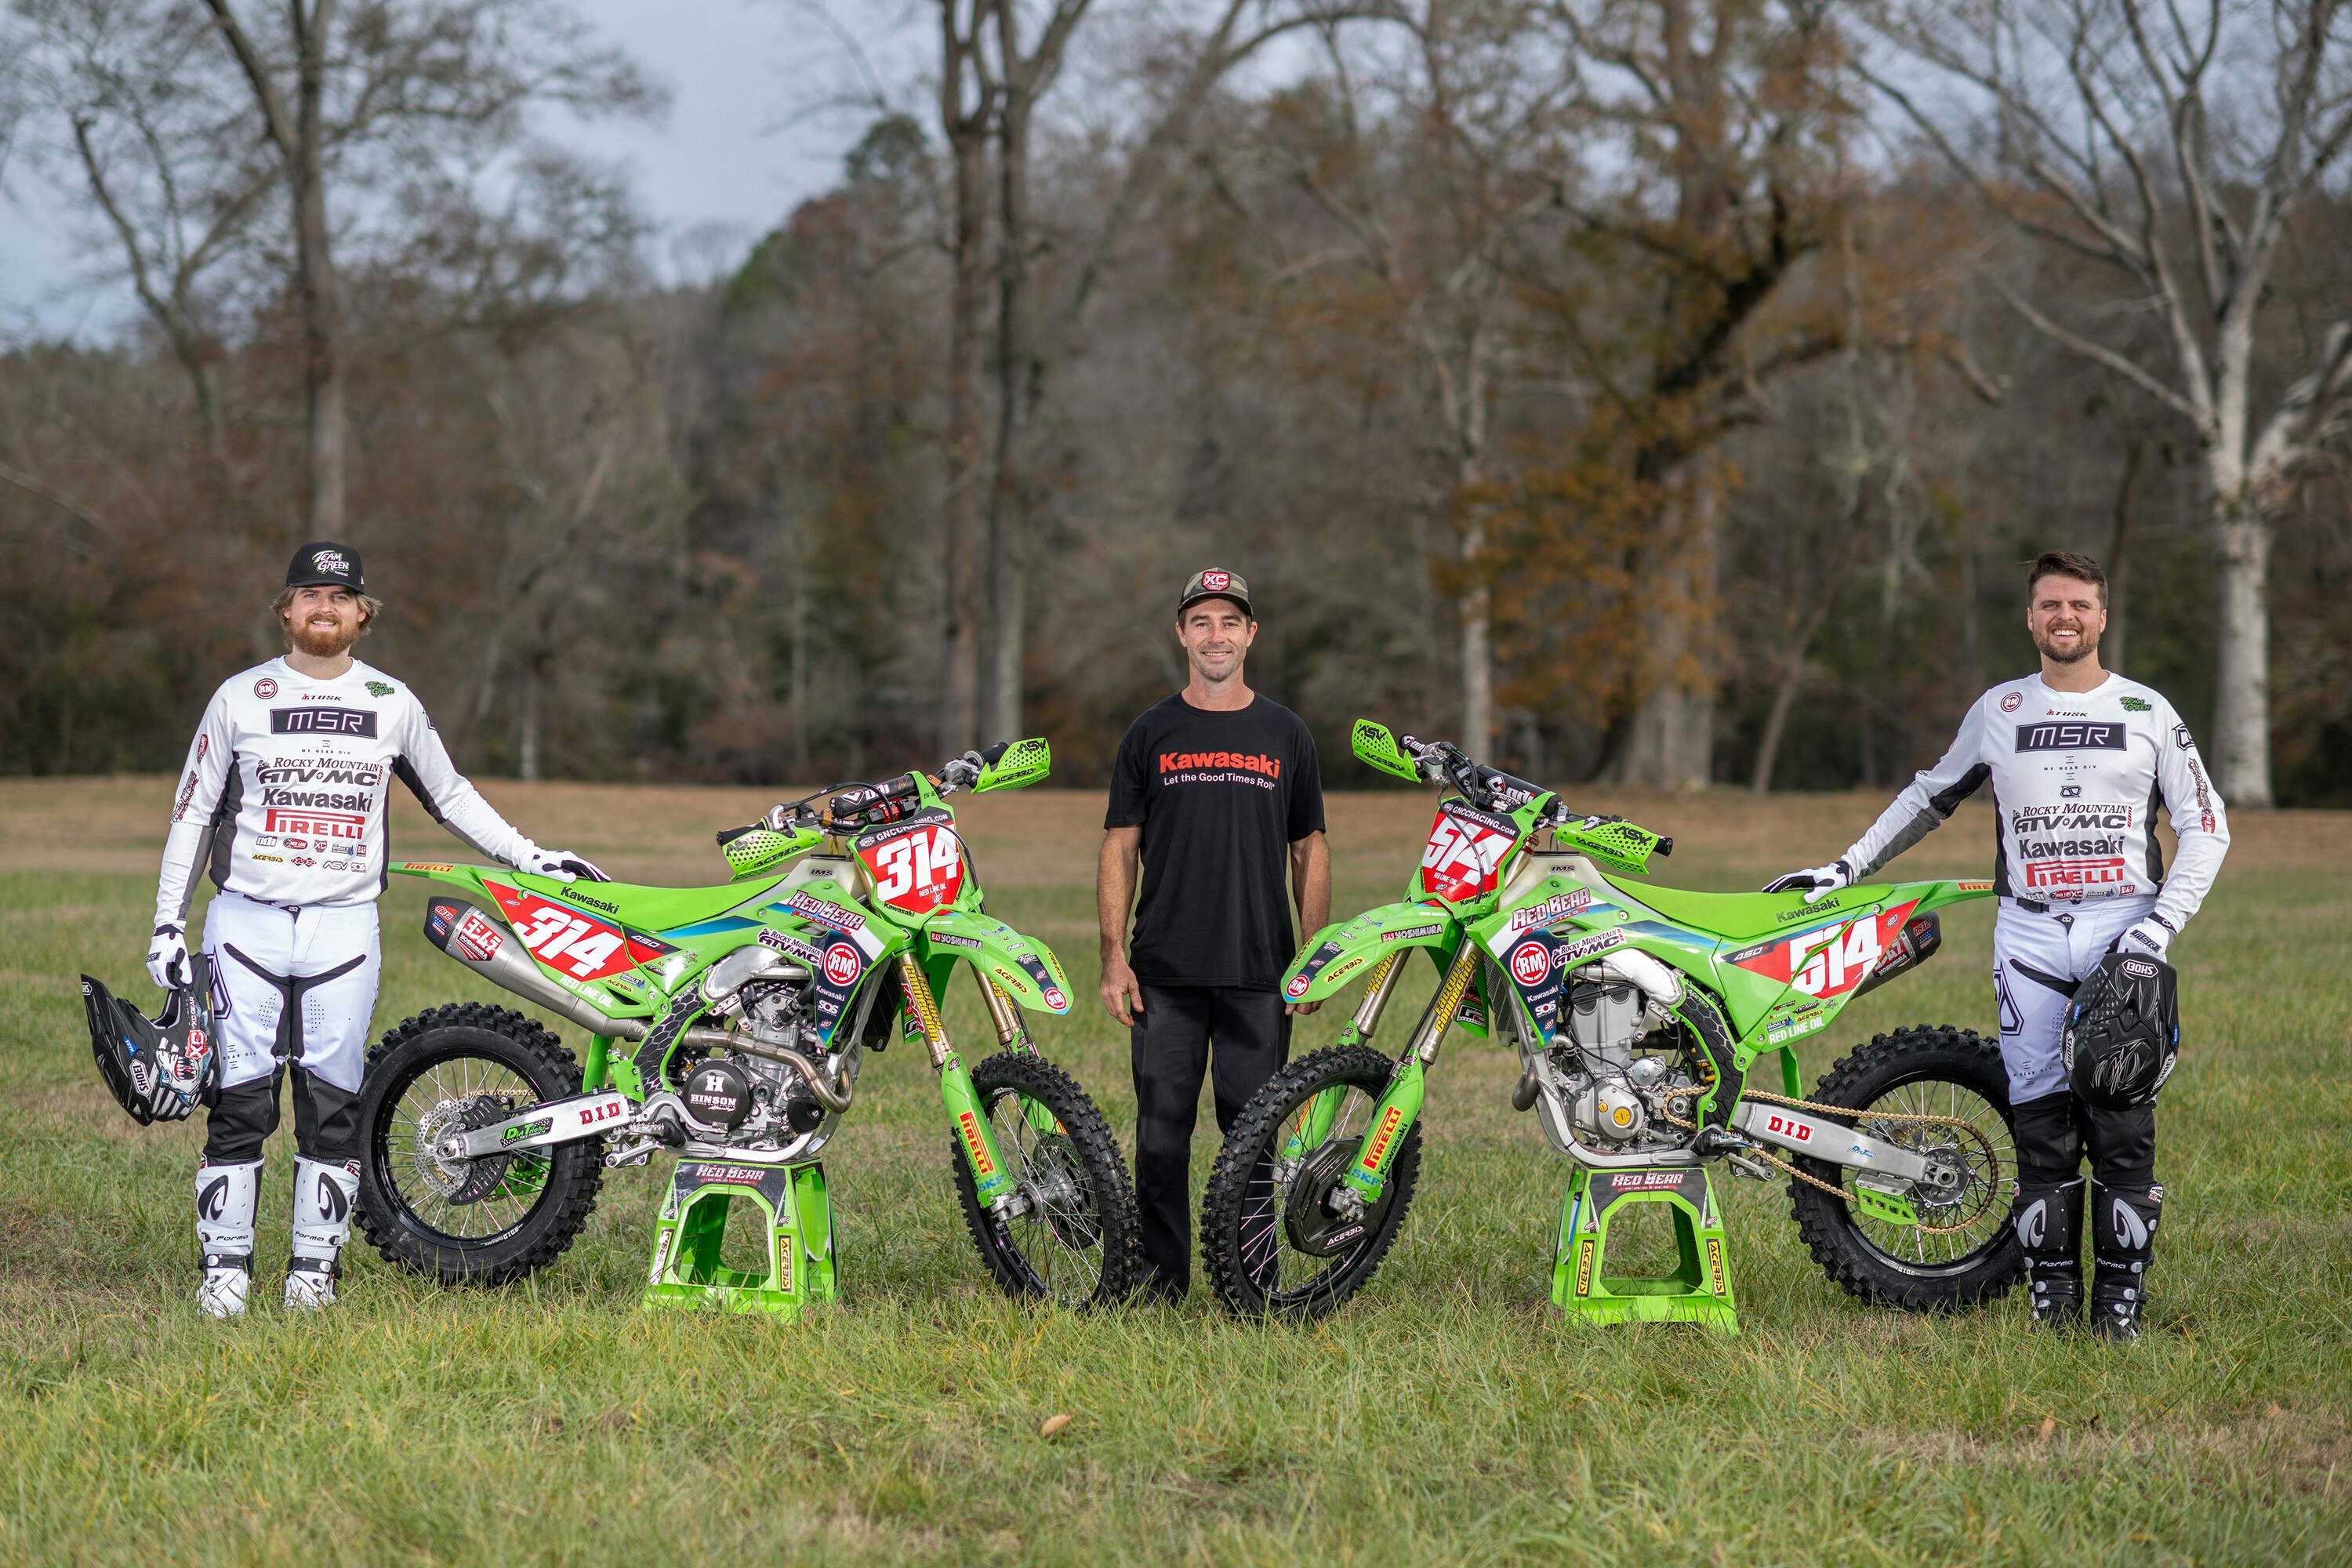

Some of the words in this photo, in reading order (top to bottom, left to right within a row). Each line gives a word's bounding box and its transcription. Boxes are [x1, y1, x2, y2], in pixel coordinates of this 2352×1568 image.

[318, 561, 349, 573] GREEN
[1203, 574, 1229, 586] XC
[286, 711, 364, 733] MSR
[1357, 725, 1387, 741] ASV
[2029, 726, 2111, 747] MSR
[273, 757, 315, 768] ROCKY
[317, 758, 379, 772] MOUNTAIN
[1160, 751, 1280, 779] Kawasaki
[1164, 775, 1178, 786] Let
[1181, 773, 1197, 782] the
[1199, 773, 1225, 782] Good
[1226, 773, 1255, 784] Times
[261, 788, 373, 813] Kawasaki
[2023, 805, 2060, 817] ROCKY
[2063, 804, 2128, 815] MOUNTAIN
[265, 808, 366, 840] PIRELLI
[1452, 807, 1516, 837] GNCCRACING.COM
[1613, 826, 1653, 845] ASV
[1422, 816, 1515, 886] 514
[2019, 836, 2125, 859] Kawasaki
[402, 862, 455, 873] PIRELLI
[876, 823, 960, 902] 314
[2026, 858, 2125, 887] PIRELLI
[1958, 882, 1994, 891] PIRE
[561, 886, 620, 916] Kawasaki
[884, 902, 915, 917] Kawasaki
[1460, 892, 1491, 906] Kawaki
[1511, 903, 1548, 931] RED
[1546, 887, 1592, 917] BEAR
[787, 889, 823, 914] RED
[818, 900, 866, 931] BEAR
[1775, 897, 1841, 923] Kawasaki
[514, 906, 624, 978] 314
[941, 934, 982, 950] YOSHIMURA
[1394, 924, 1443, 940] YOSHIMURA
[1561, 942, 1580, 954] ROCKY
[1581, 930, 1617, 946] MOUNTAIN
[2133, 931, 2157, 949] MSR
[771, 931, 792, 945] ROCKY
[792, 939, 820, 956] MOUNTAIN
[831, 954, 855, 975] RM
[1518, 955, 1545, 975] RM
[1788, 915, 1882, 996] 514
[1878, 954, 1908, 976] YOSHIMURA
[2126, 960, 2154, 976] SHOEI
[560, 975, 580, 990] RED
[577, 983, 601, 1001] LINE
[597, 993, 615, 1008] OIL
[816, 985, 845, 1002] Kawasaki
[1526, 985, 1559, 1004] Kawasaki
[818, 1000, 839, 1014] SOS
[1534, 1000, 1557, 1017] SOS
[1769, 1029, 1788, 1045] RED
[1788, 1021, 1809, 1038] LINE
[1809, 1016, 1825, 1030] OIL
[188, 1032, 205, 1059] XC
[132, 1065, 149, 1091] SHOEI
[705, 1075, 725, 1093] H
[690, 1094, 737, 1106] HINSON
[959, 1111, 995, 1174] PIRELLI
[1362, 1105, 1403, 1171] PIRELLI
[1379, 1123, 1409, 1175] Kawasaki
[695, 1165, 726, 1178] RED
[726, 1166, 765, 1180] BEAR
[978, 1174, 1004, 1192] SKF
[1351, 1168, 1381, 1186] SKF
[1611, 1174, 1641, 1186] RED
[1644, 1173, 1685, 1185] BEAR
